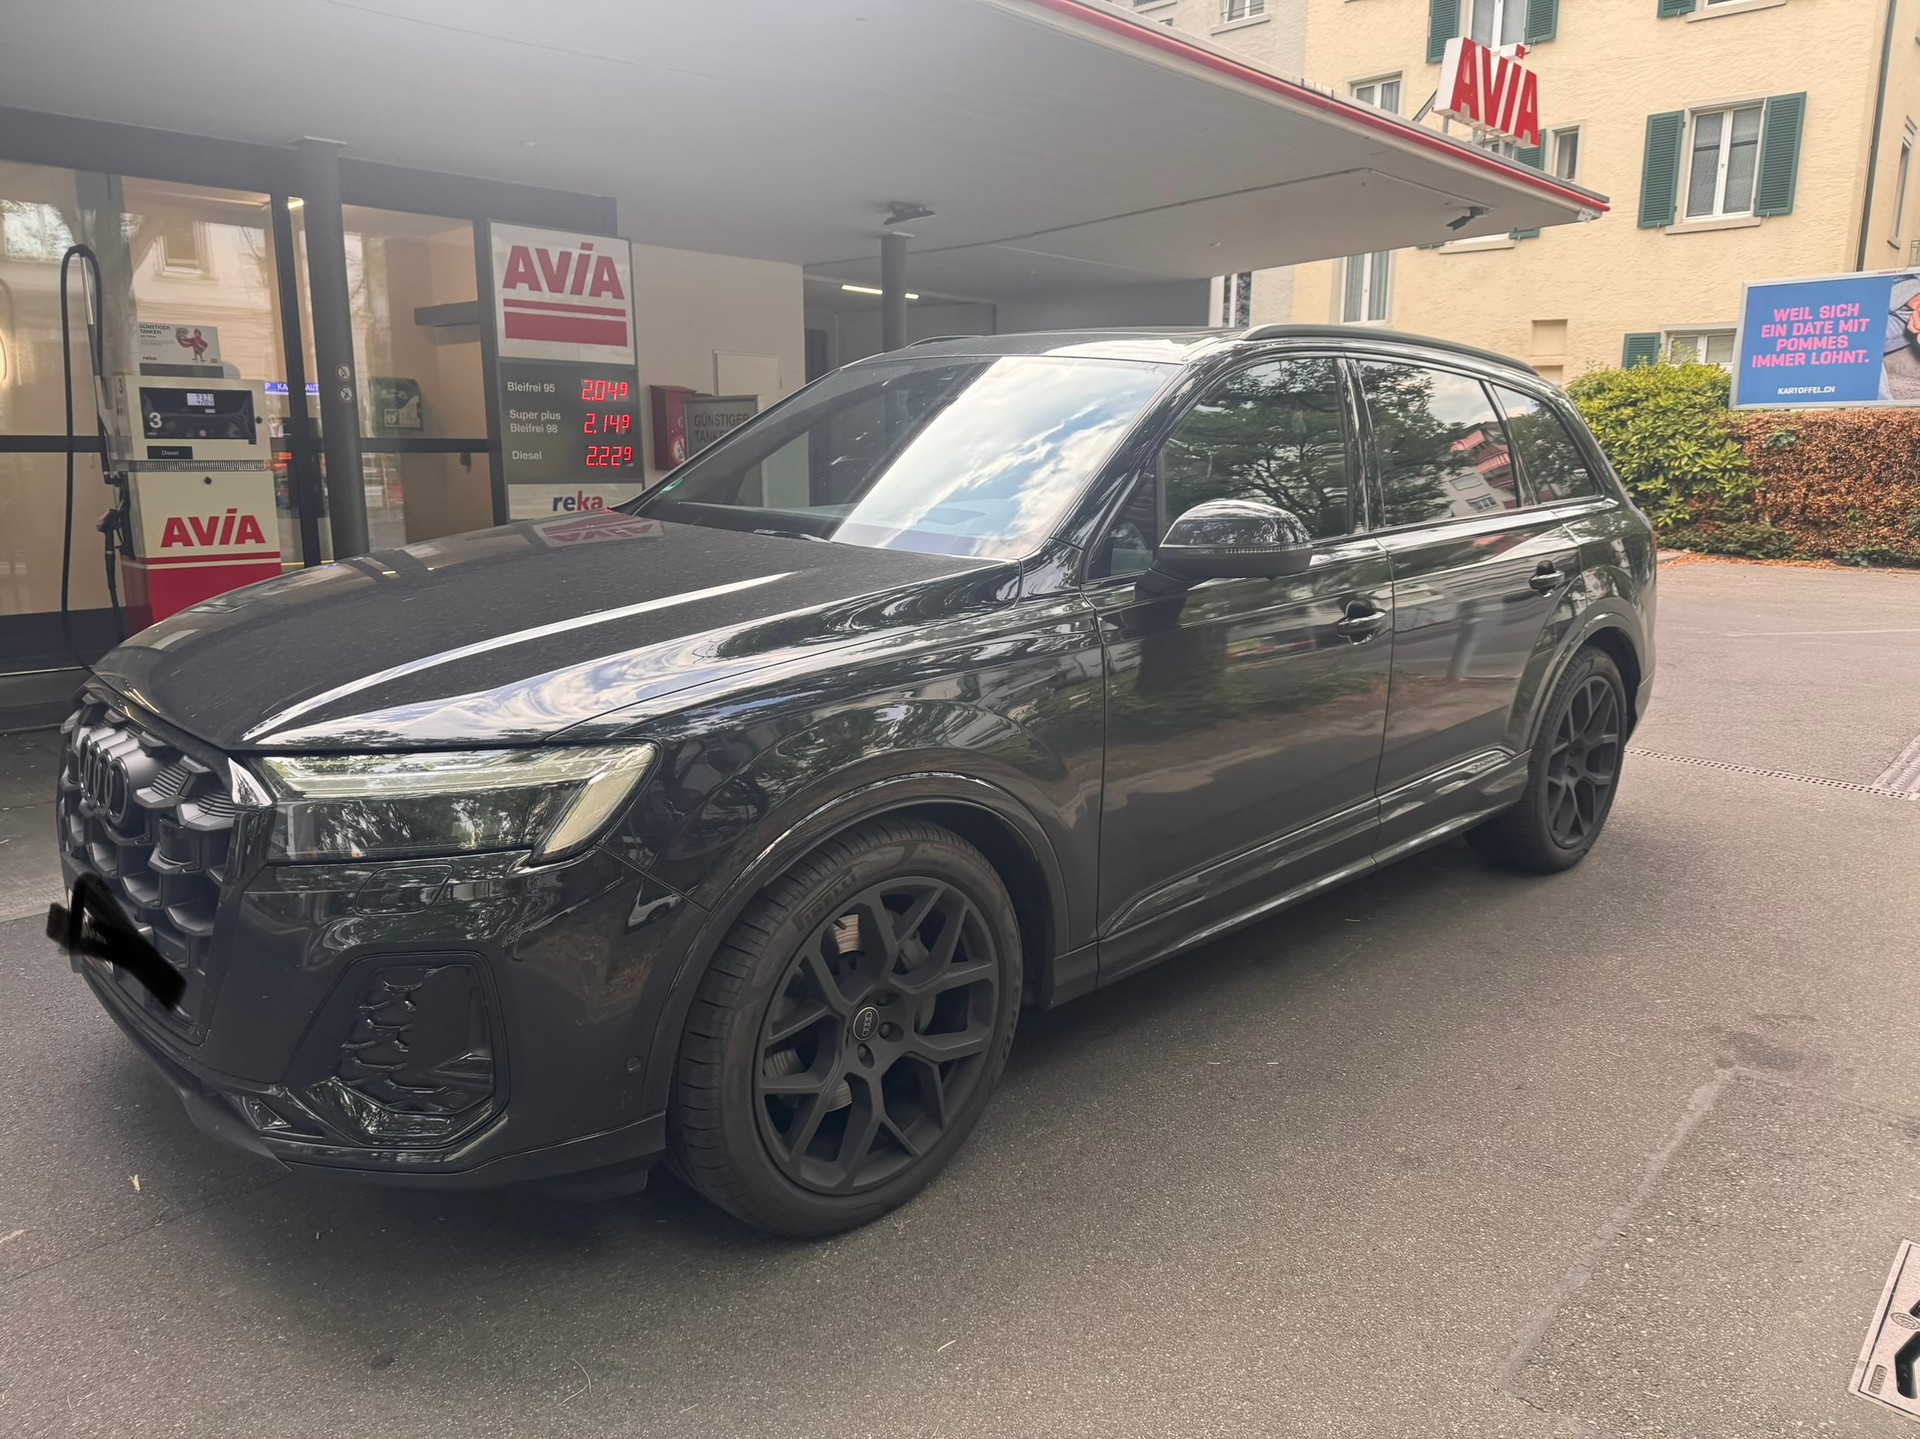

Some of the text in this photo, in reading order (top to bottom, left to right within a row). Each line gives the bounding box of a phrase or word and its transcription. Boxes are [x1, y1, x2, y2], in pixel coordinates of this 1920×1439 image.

[1450, 37, 1540, 148] AVIA
[502, 242, 626, 301] AVIA
[1773, 303, 1860, 322] WEIL SICH
[1761, 318, 1870, 338] EIN DATE MIT
[1776, 335, 1848, 352] POMMES
[1752, 350, 1869, 368] IMMER LOHNT.
[507, 381, 555, 393] Bleifrei 95
[582, 379, 629, 402] 2.049
[1777, 385, 1836, 395] KARTOFFEL.CH
[149, 411, 163, 429] 3
[509, 409, 561, 421] Super plus
[584, 413, 631, 434] 2.149
[510, 423, 558, 433] Bleifrei 98
[695, 430, 728, 443] TANKE
[512, 450, 542, 460] Diesel
[586, 446, 633, 467] 2.229
[552, 490, 604, 512] reka
[161, 508, 266, 548] AVIA
[791, 867, 857, 932] PIRELLI
